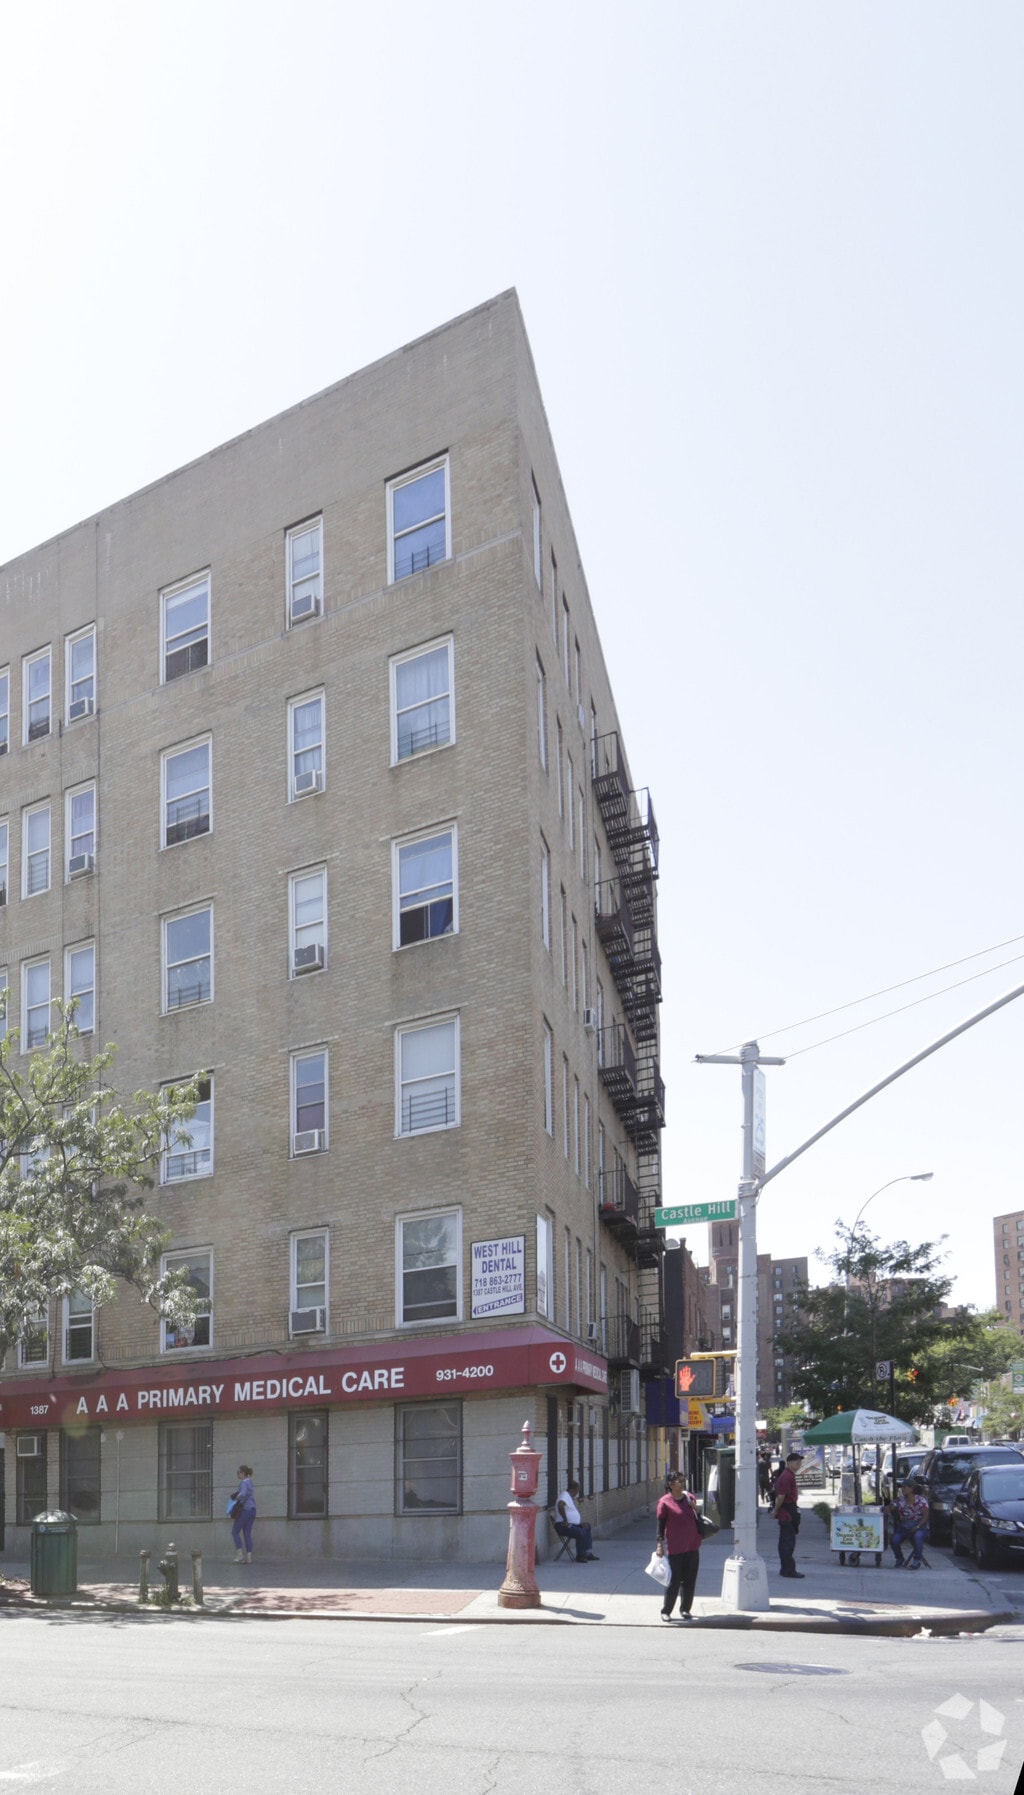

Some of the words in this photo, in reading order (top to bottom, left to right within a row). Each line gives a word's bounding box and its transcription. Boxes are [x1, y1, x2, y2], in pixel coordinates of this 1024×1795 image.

[661, 1206, 702, 1220] Castle
[708, 1201, 730, 1215] Hill
[683, 1216, 708, 1224] Avenue
[474, 1243, 499, 1259] WEST
[502, 1240, 522, 1256] HILL
[482, 1257, 517, 1273] DENTAL
[475, 1277, 488, 1287] 718
[489, 1273, 522, 1286] 863-2777
[484, 1286, 501, 1295] CASTLE
[502, 1284, 512, 1292] HILL
[478, 1294, 522, 1313] ENTRANCE
[436, 1365, 494, 1381] 931-4200
[76, 1396, 88, 1414] A
[96, 1395, 108, 1412] A
[116, 1393, 129, 1411] A
[137, 1384, 225, 1409] PRIMARY
[234, 1375, 331, 1402] MEDICAL
[341, 1367, 405, 1393] CARE
[31, 1405, 49, 1415] 1387
